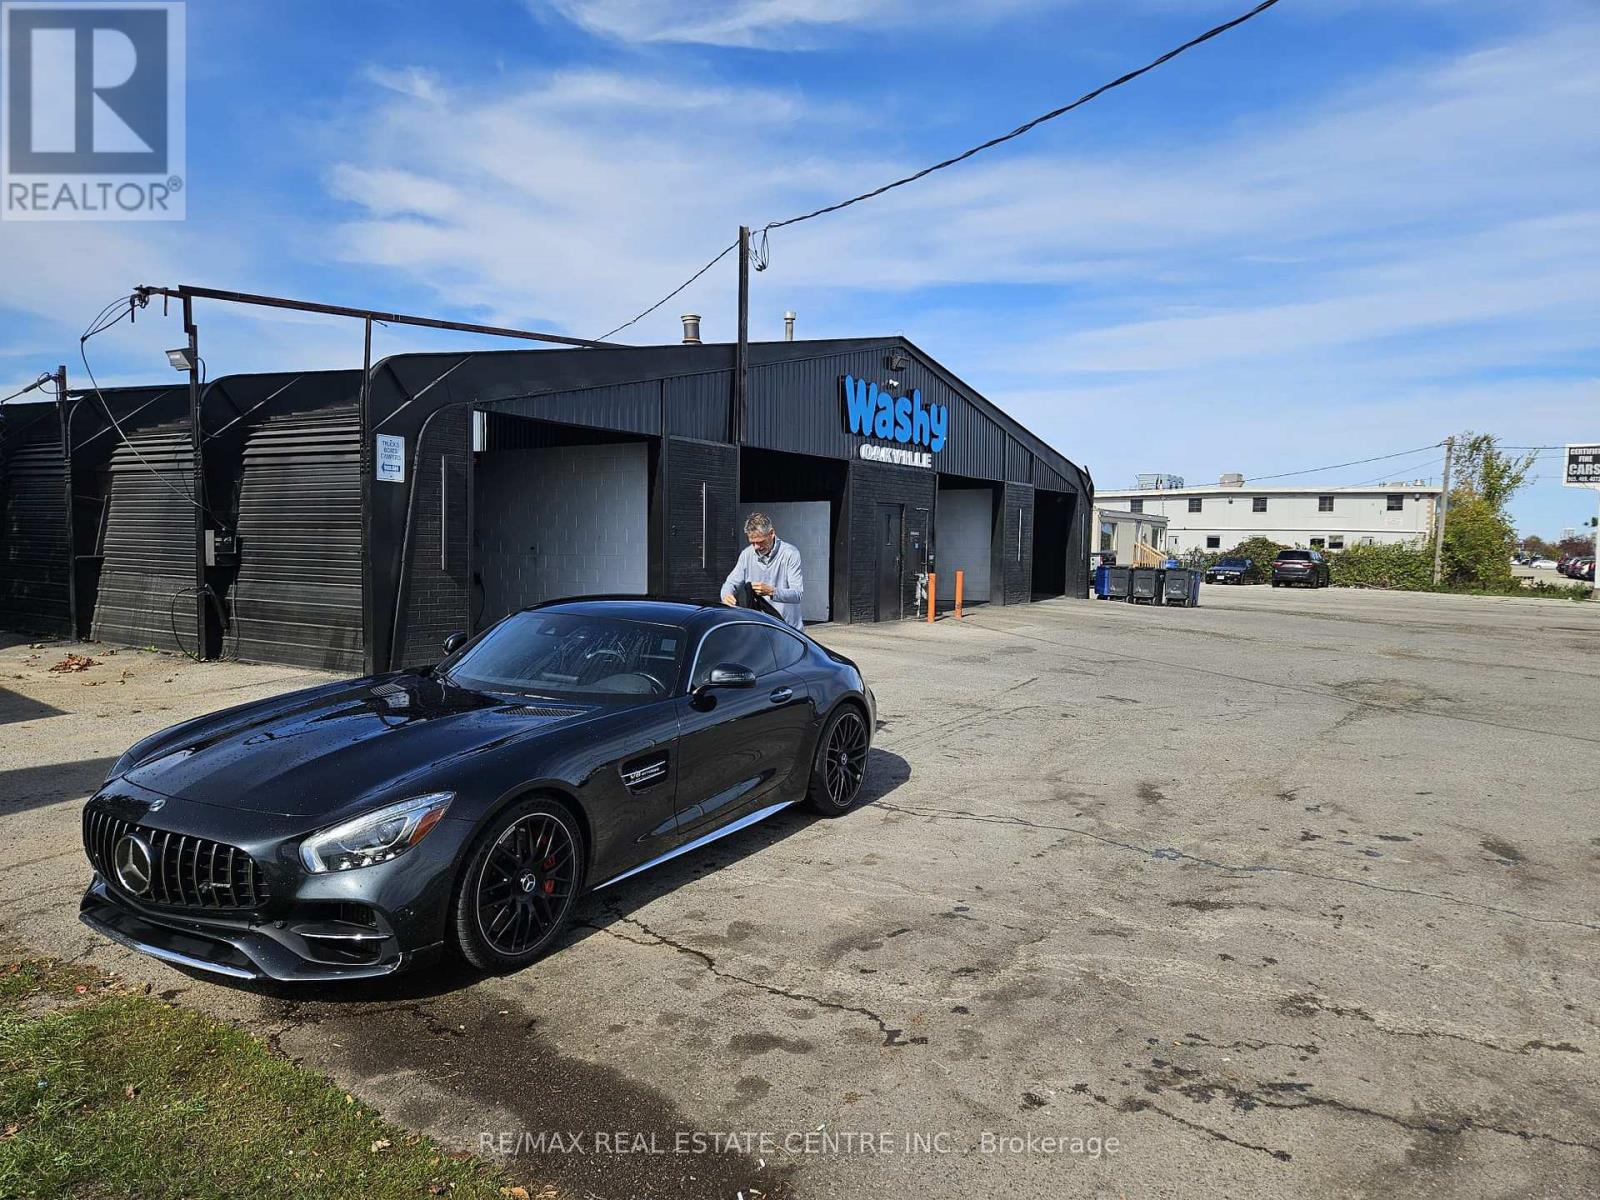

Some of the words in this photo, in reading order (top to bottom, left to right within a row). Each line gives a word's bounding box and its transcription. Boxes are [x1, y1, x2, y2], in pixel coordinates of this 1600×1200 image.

[845, 374, 948, 453] Washy
[860, 443, 932, 468] OAKVILLE
[1568, 463, 1600, 476] CARS
